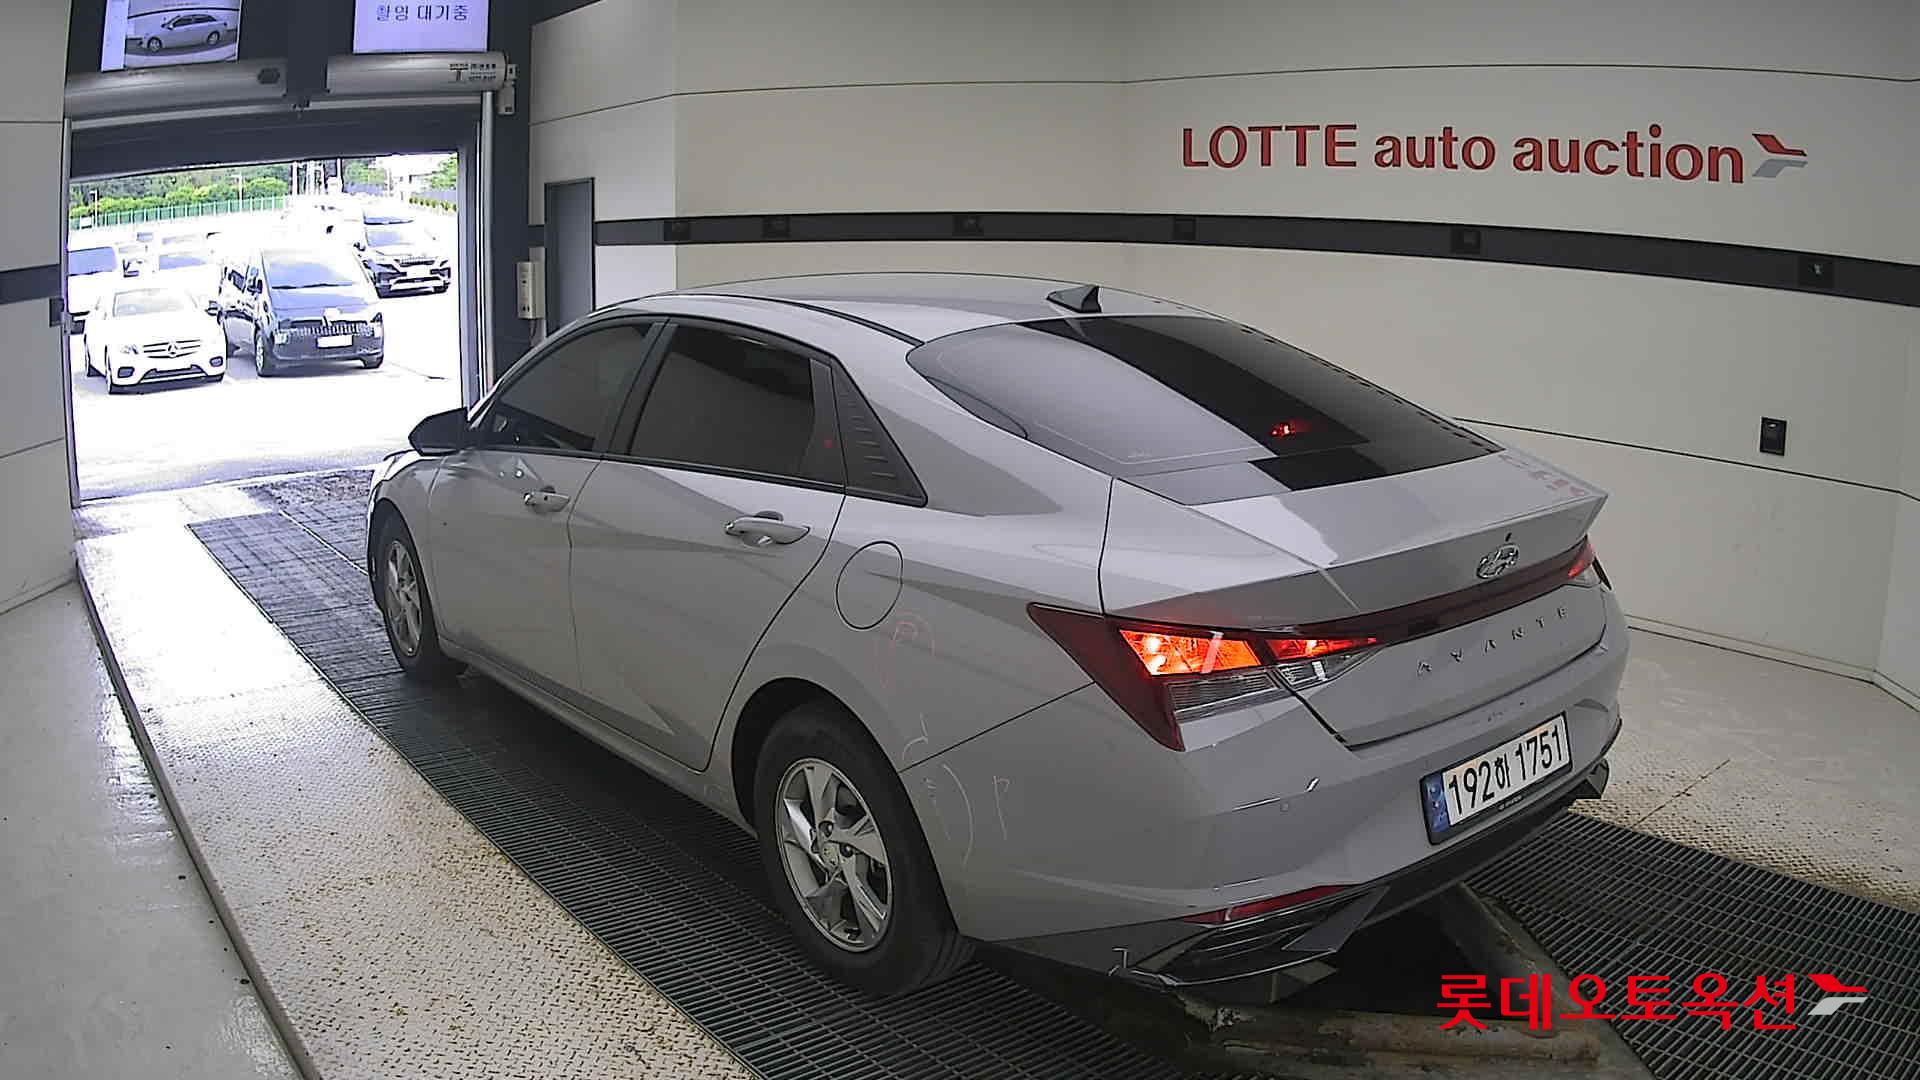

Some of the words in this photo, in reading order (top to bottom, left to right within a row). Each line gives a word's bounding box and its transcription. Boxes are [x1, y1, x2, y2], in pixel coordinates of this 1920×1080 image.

[417, 4, 468, 21] 대기중
[1182, 124, 1357, 168] LOTTE
[1373, 126, 1496, 170] auto
[1512, 124, 1744, 184] auction
[1416, 606, 1569, 676] AVANTE
[1448, 753, 1511, 815] 192하
[1515, 724, 1563, 781] 1751
